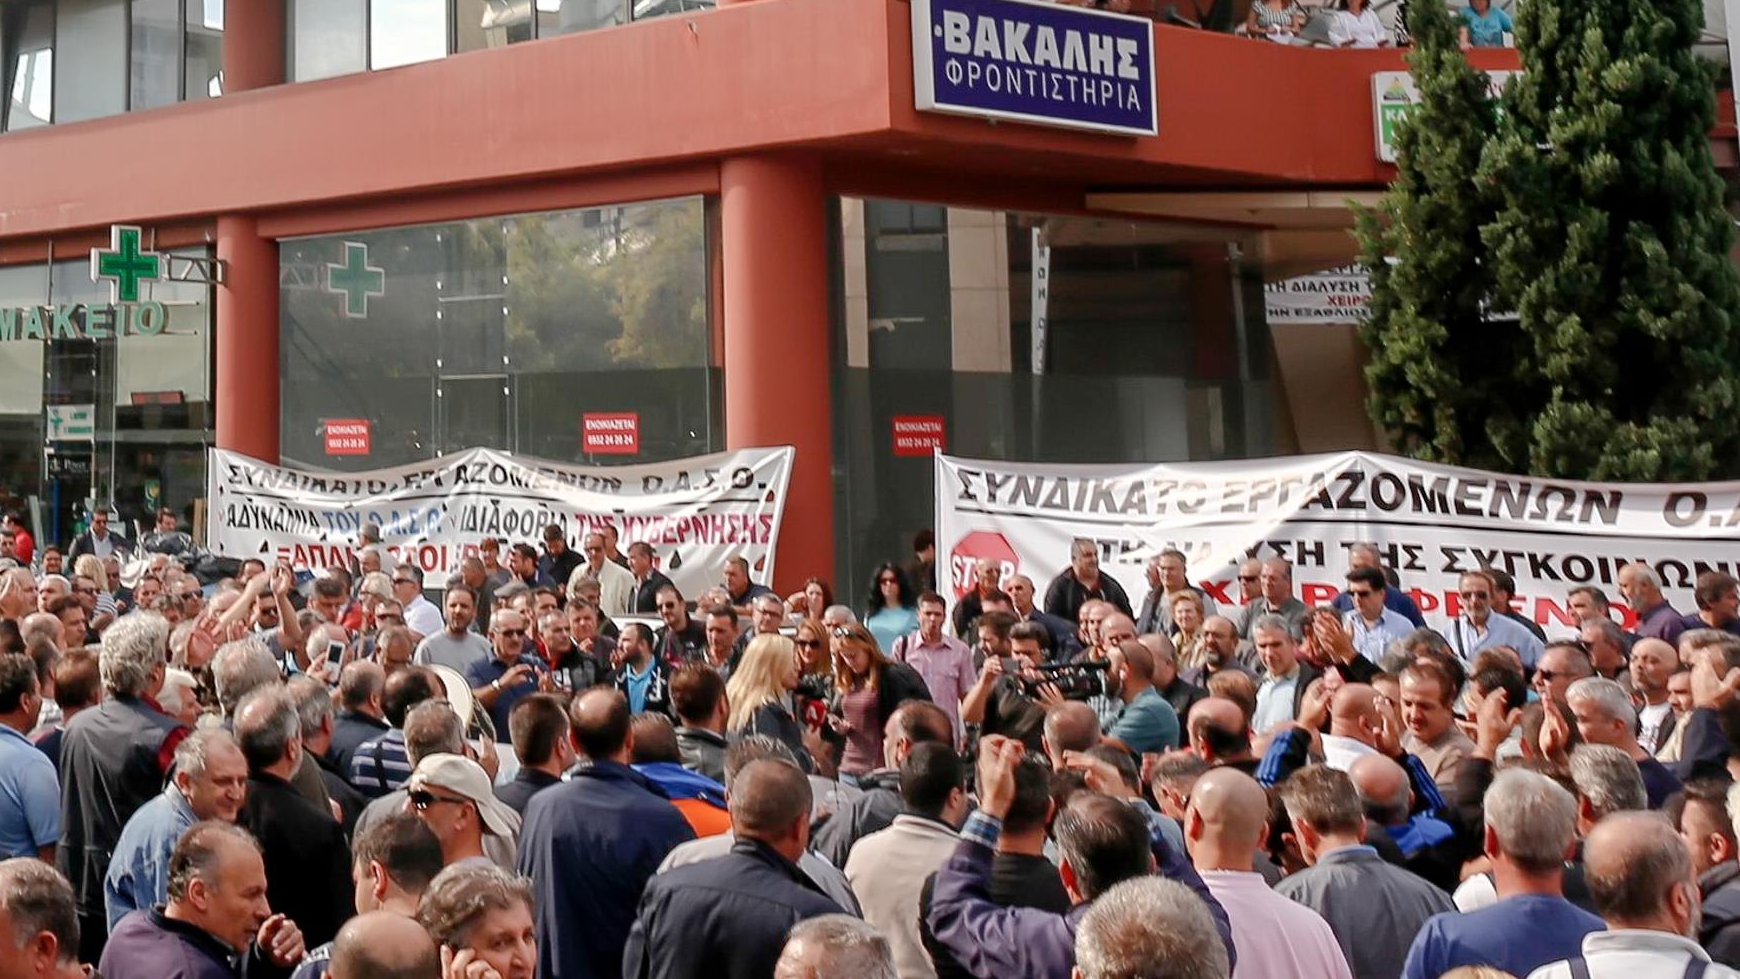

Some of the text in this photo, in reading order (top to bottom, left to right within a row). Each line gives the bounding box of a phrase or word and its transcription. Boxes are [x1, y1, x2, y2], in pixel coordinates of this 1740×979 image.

[943, 9, 1140, 81] ΒΑΚΑΛΗΣ
[946, 57, 1142, 112] ΦΡΟΝΤΙΣΤΗΡΙΑ
[1292, 281, 1360, 292] ΔΙΑΛΥΣΗ
[957, 468, 1207, 515] ΣΥΝΔΙΚΑΤΟ
[1220, 471, 1623, 526] ΕΡΓΑΖΟΜΕΝΩΝ
[952, 554, 1017, 587] STP
